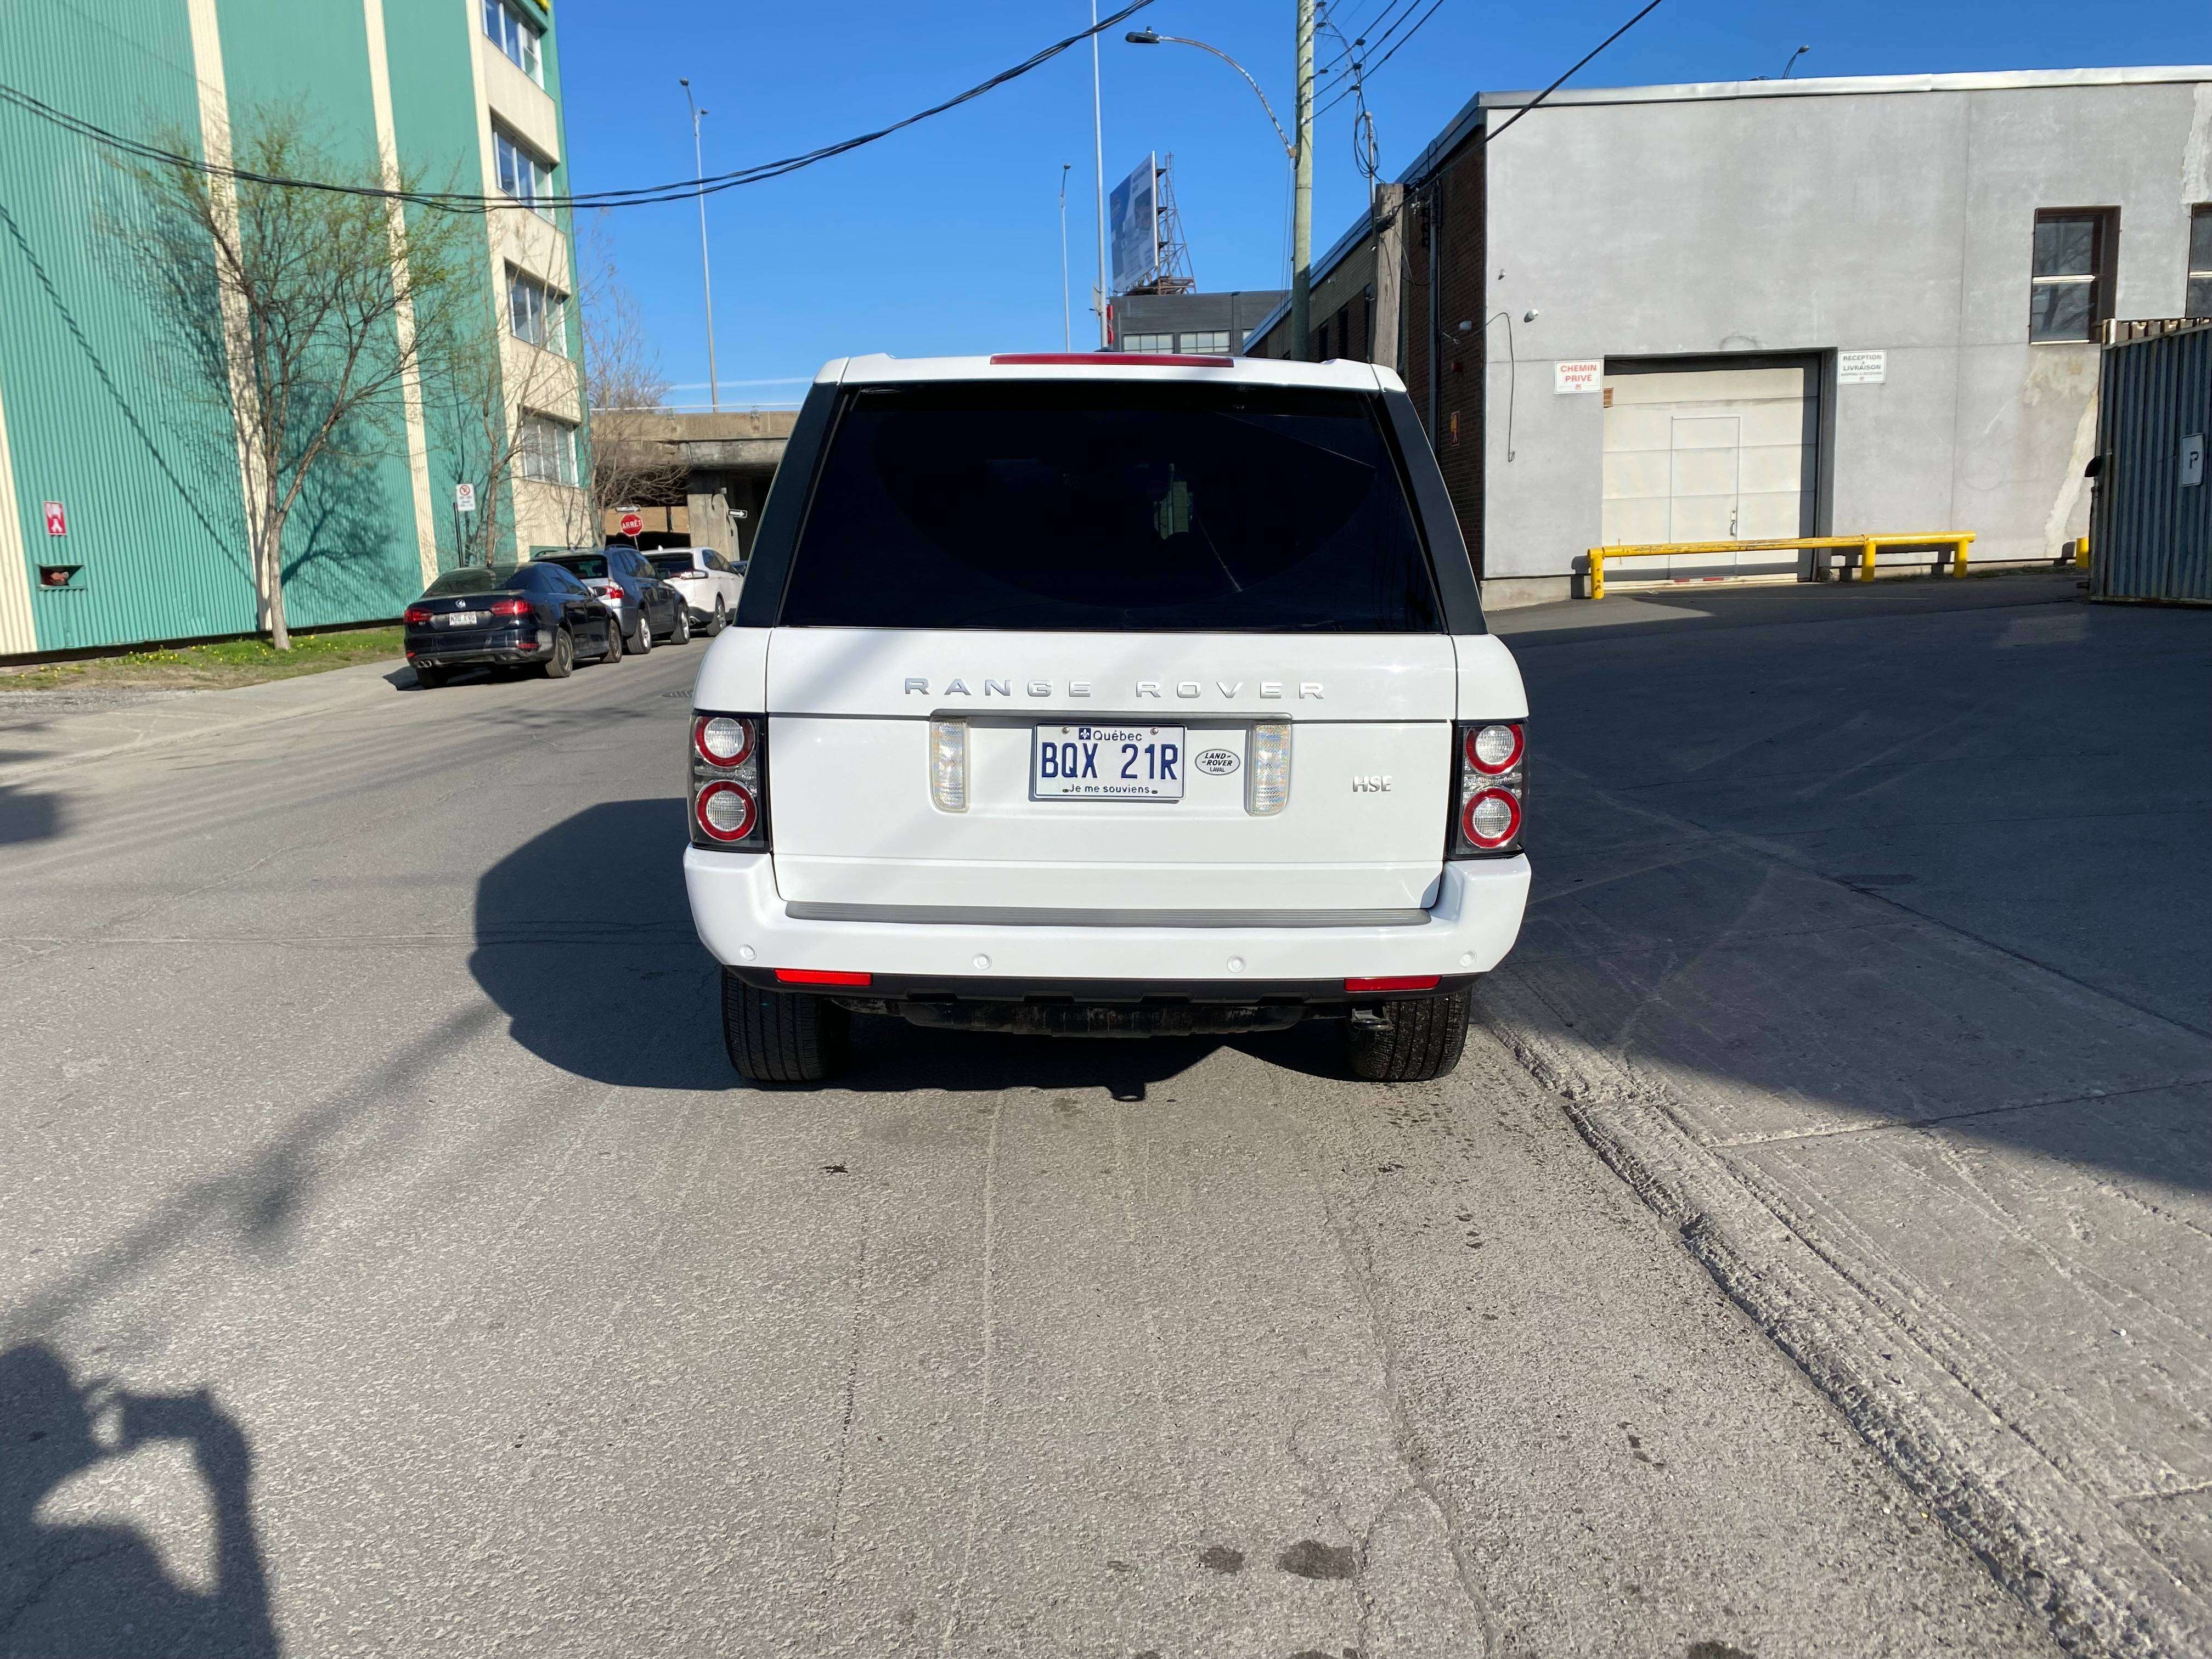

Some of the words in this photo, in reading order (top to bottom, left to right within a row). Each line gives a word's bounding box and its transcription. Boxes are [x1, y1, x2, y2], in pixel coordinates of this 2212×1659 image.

[1560, 364, 1597, 373] CHEMIN
[2190, 451, 2199, 469] P
[622, 518, 641, 529] ARRÊT
[905, 678, 1091, 697] RANGE
[1136, 680, 1324, 699] ROVER
[1093, 730, 1143, 741] Québec
[1041, 742, 1098, 778] BQX
[1121, 743, 1178, 780] 21R
[1070, 783, 1081, 793] Je
[1103, 783, 1150, 793] souviens
[1352, 775, 1393, 792] HSE
